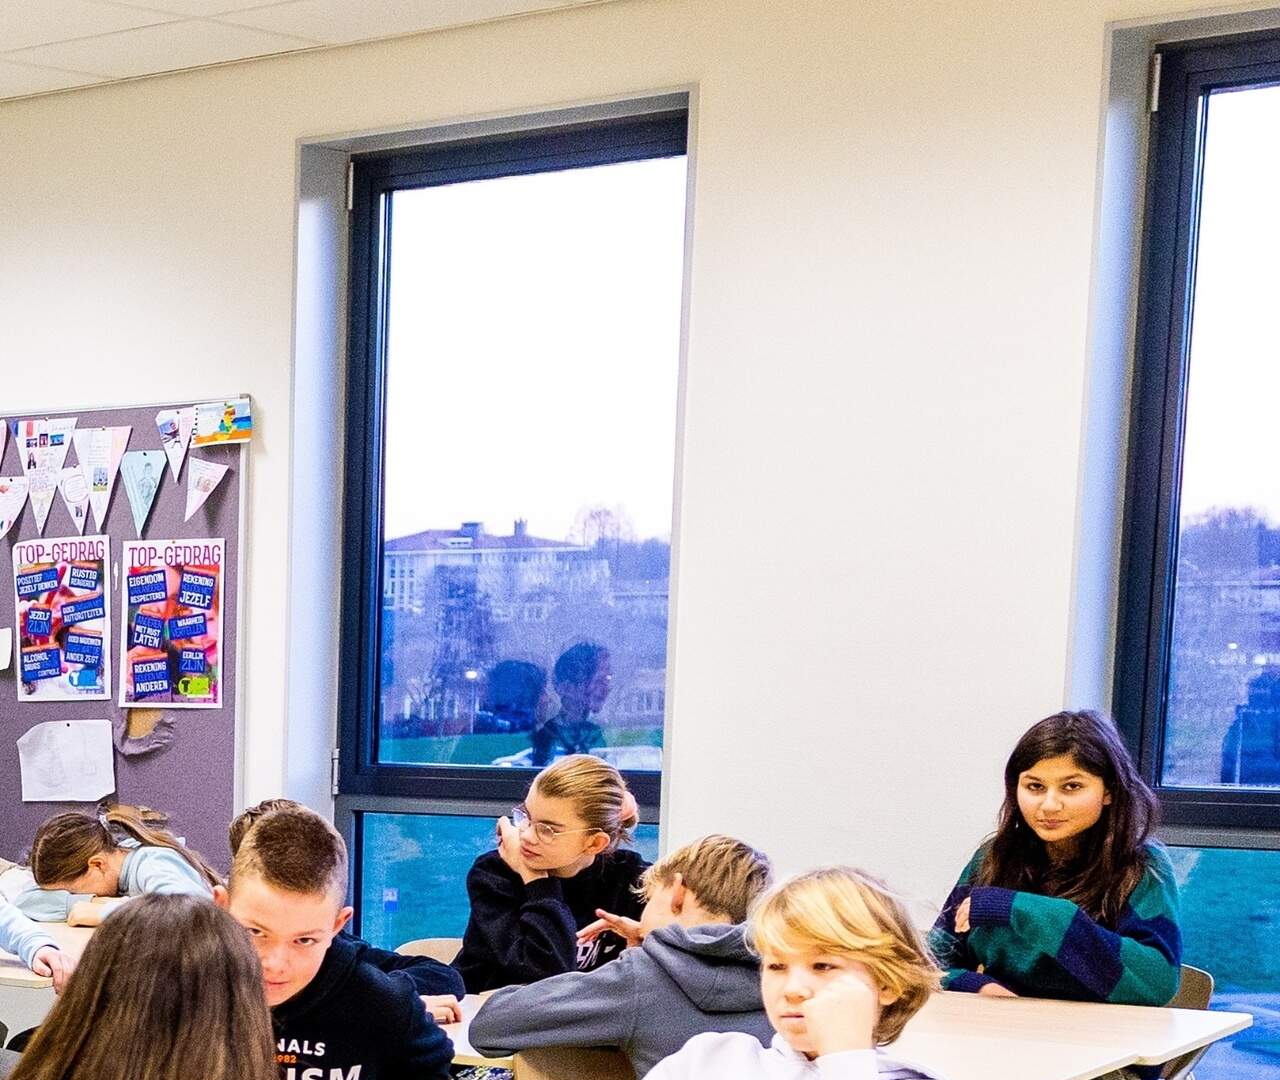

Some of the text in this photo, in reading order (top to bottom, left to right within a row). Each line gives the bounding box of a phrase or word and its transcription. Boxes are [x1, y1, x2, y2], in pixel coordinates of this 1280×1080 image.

[17, 540, 105, 564] TOP-GEDRAG
[129, 545, 221, 567] TOP-GEDRAG
[72, 568, 98, 579] RUSTIG
[129, 572, 164, 587] EIGENDOM
[180, 591, 211, 607] JEZELF
[29, 610, 51, 620] JEZELF
[133, 632, 160, 648] LATEN
[181, 659, 204, 672] ZIJN
[136, 680, 168, 693] ANDEREN
